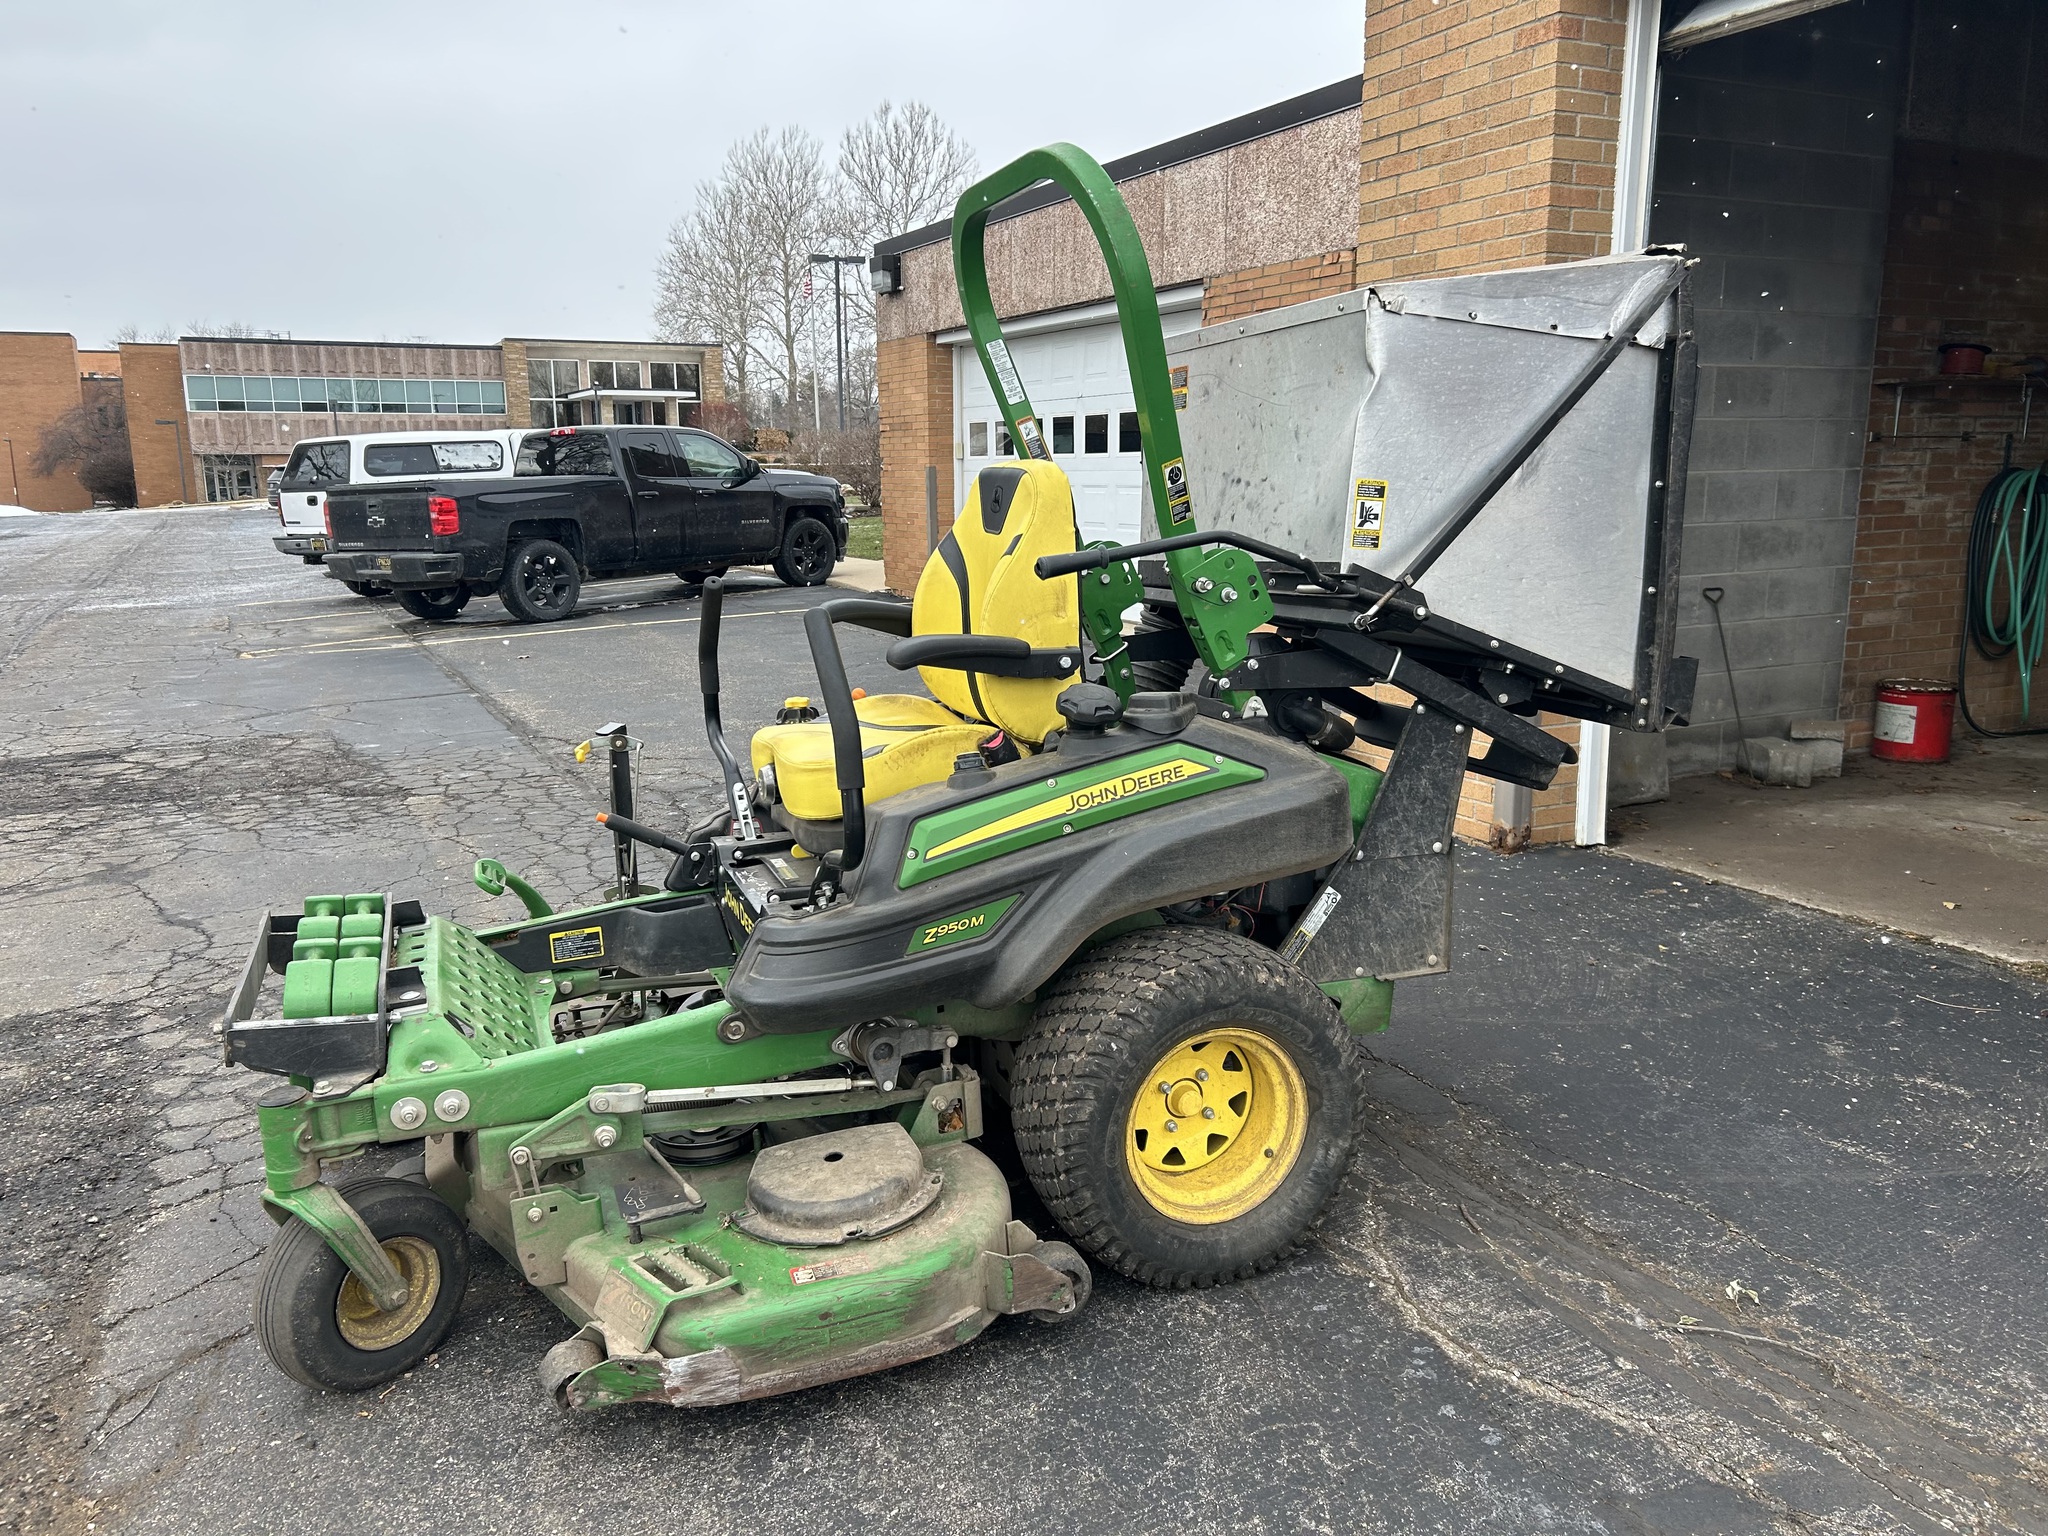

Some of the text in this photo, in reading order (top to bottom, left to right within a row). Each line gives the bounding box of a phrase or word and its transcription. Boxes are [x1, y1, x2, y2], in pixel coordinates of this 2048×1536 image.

[1066, 765, 1185, 812] JOHN DEERE
[923, 914, 985, 945] Z950M
